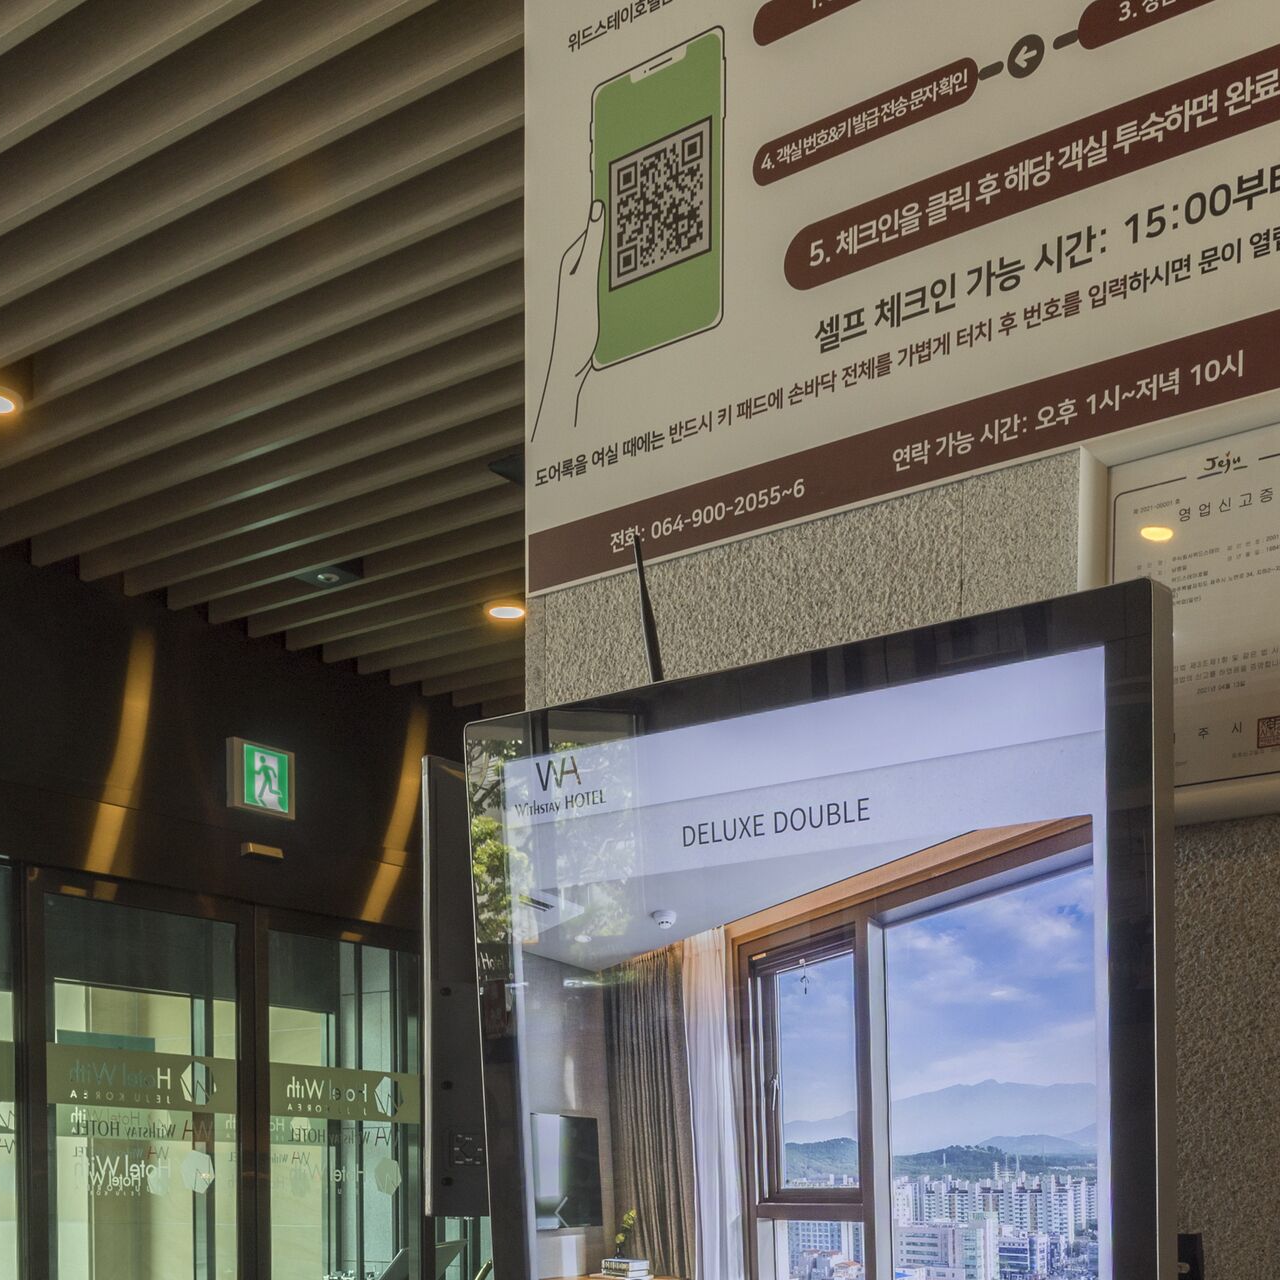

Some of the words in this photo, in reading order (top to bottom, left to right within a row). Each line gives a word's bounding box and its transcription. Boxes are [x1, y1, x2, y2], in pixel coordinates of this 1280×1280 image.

[809, 240, 831, 267] 5.
[836, 203, 922, 256] 체크인을
[925, 185, 970, 227] 클릭
[977, 178, 1000, 204] 후
[1004, 154, 1052, 193] 해당
[1058, 130, 1107, 171] 객실
[1113, 90, 1218, 155] 투숙하면
[1225, 68, 1280, 112] 완료
[814, 308, 867, 354] 셀프
[873, 271, 956, 327] 체크인
[967, 256, 1025, 295] 가능
[1035, 224, 1107, 275] 시간:
[535, 453, 588, 487] 도어록을
[591, 442, 619, 470] 여실
[623, 425, 665, 457] 때에는
[669, 410, 713, 442] 반드시
[718, 409, 732, 426] 키
[736, 387, 783, 421] 패드에
[787, 370, 837, 404] 손바닥
[841, 353, 892, 388] 전체를
[897, 331, 951, 367] 가볍게
[956, 317, 993, 350] 터치
[998, 310, 1018, 336] 후
[1023, 290, 1083, 330] 번호를
[1088, 254, 1191, 309] 입력하시면
[1198, 237, 1242, 272] 문이
[892, 437, 930, 472] 연락
[935, 429, 974, 458] 가능
[980, 414, 1027, 445] 시간:
[1035, 397, 1078, 432] 오후
[1086, 367, 1180, 415] 1시~저녁
[1189, 349, 1244, 386] 10시
[1204, 451, 1241, 473] Jeju
[651, 479, 805, 541] 064-900-2055~6
[565, 789, 606, 809] HOTEL
[681, 812, 766, 848] DELUXE
[773, 797, 871, 834] DOUBLE
